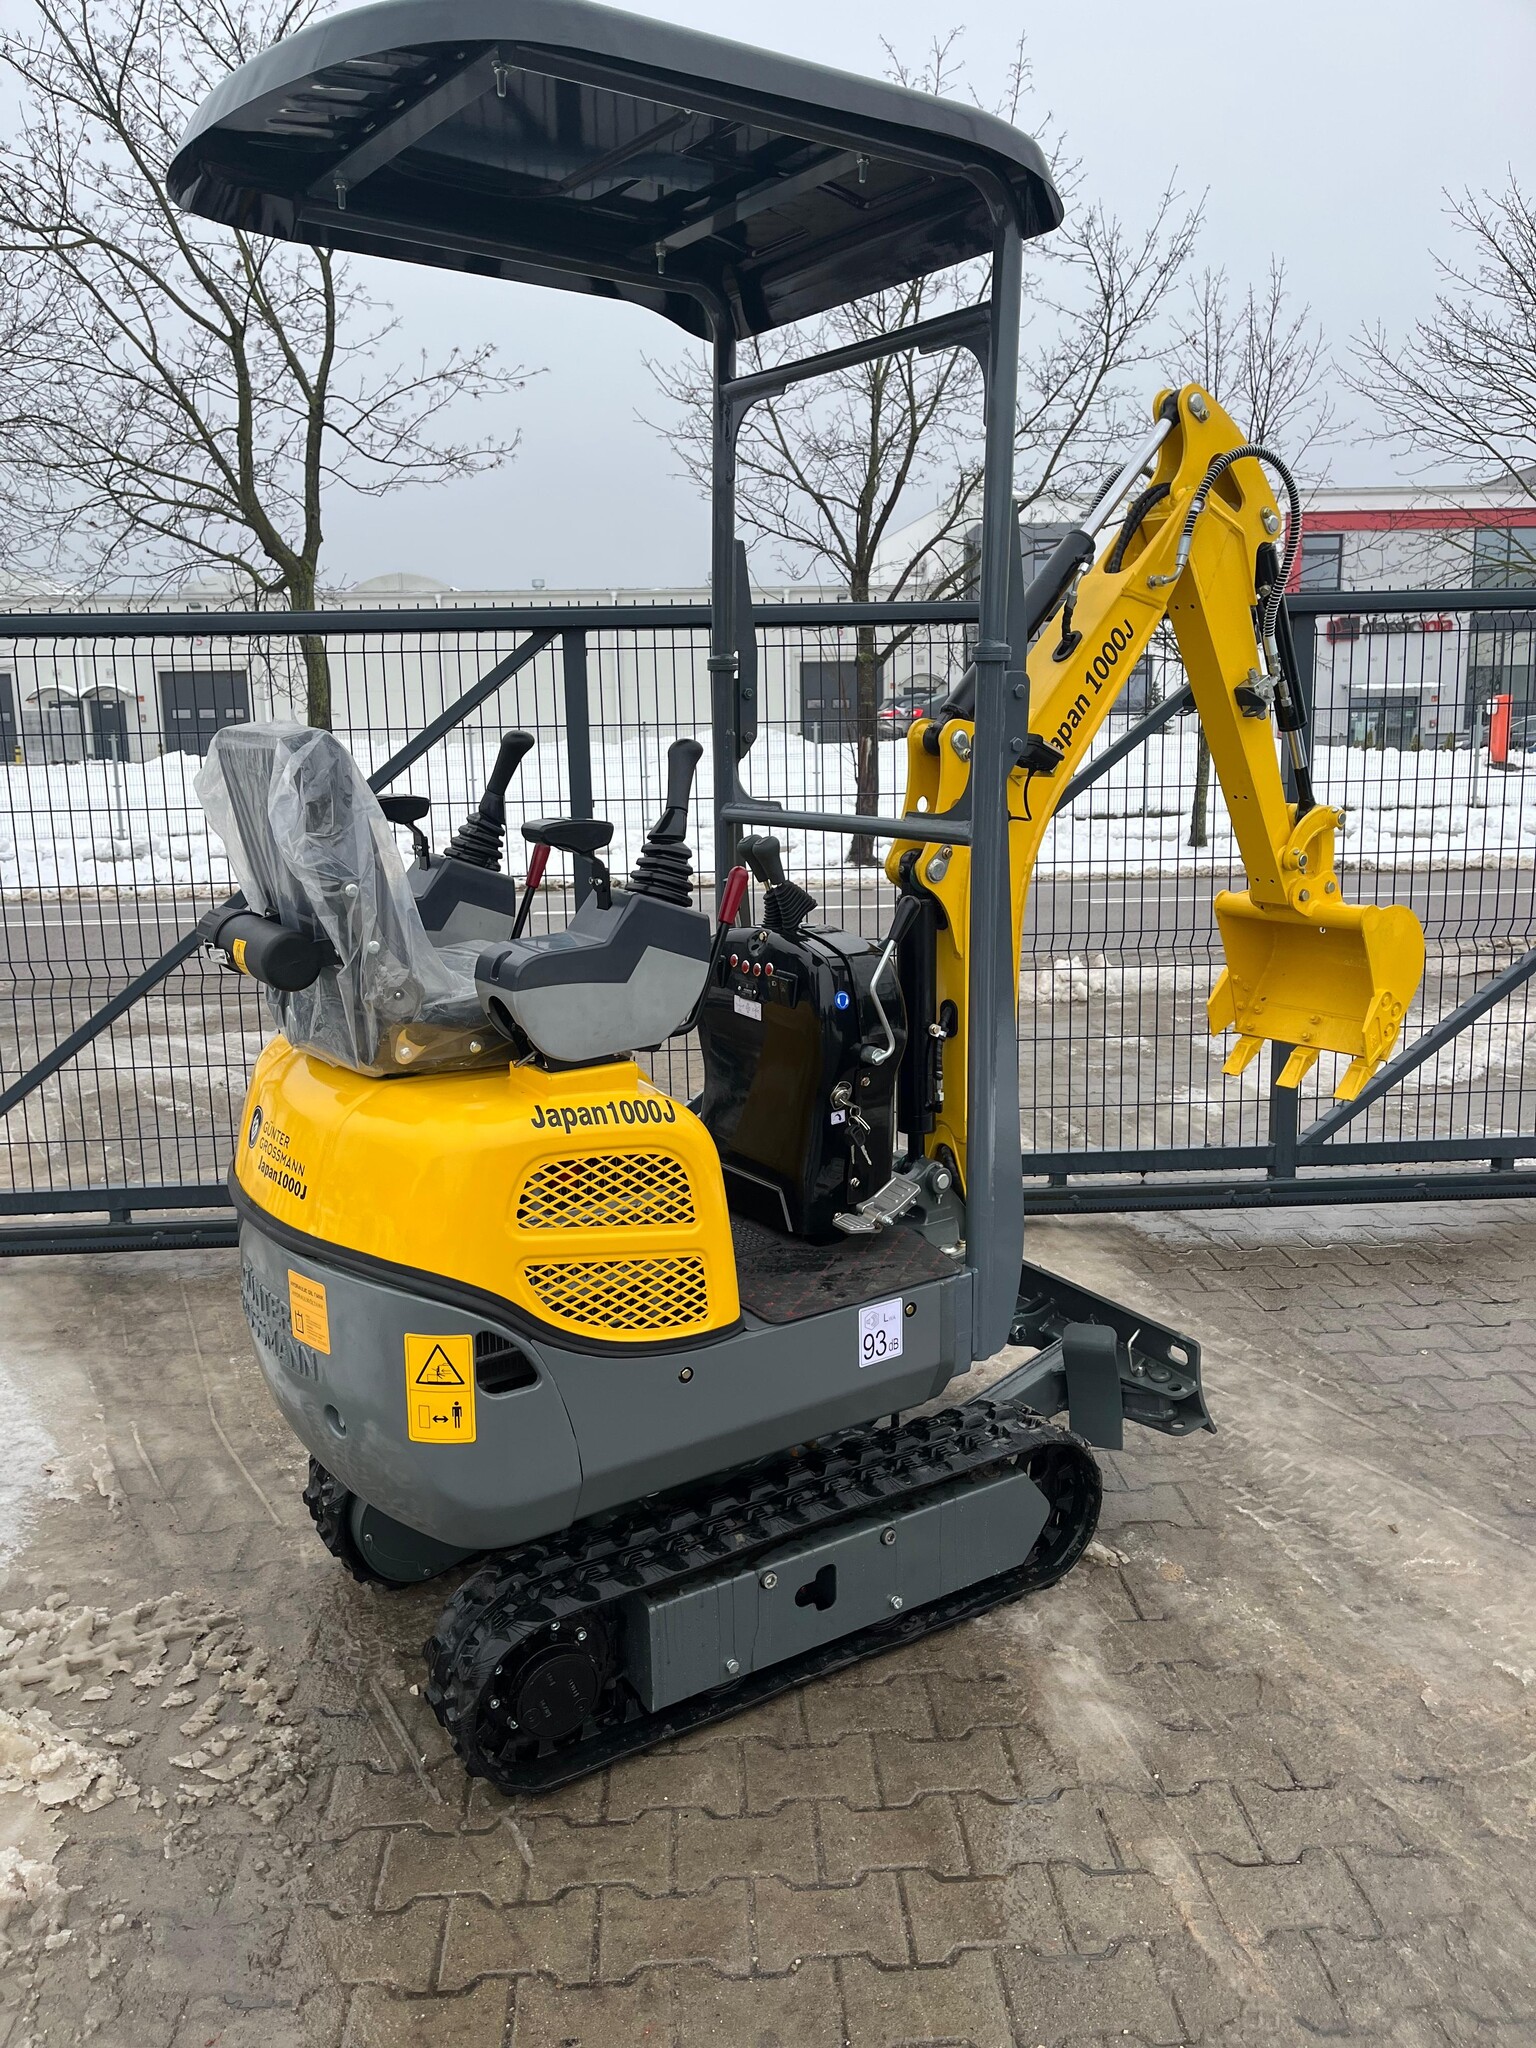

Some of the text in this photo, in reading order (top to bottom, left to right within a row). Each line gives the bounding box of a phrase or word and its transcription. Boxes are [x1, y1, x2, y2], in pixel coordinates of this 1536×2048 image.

[1050, 618, 1134, 751] apan 1000J
[530, 1099, 676, 1134] Japan1000J
[259, 1137, 306, 1177] GROSSMANN
[258, 1155, 308, 1200] Japan1000J
[863, 1329, 899, 1360] 93 dB
